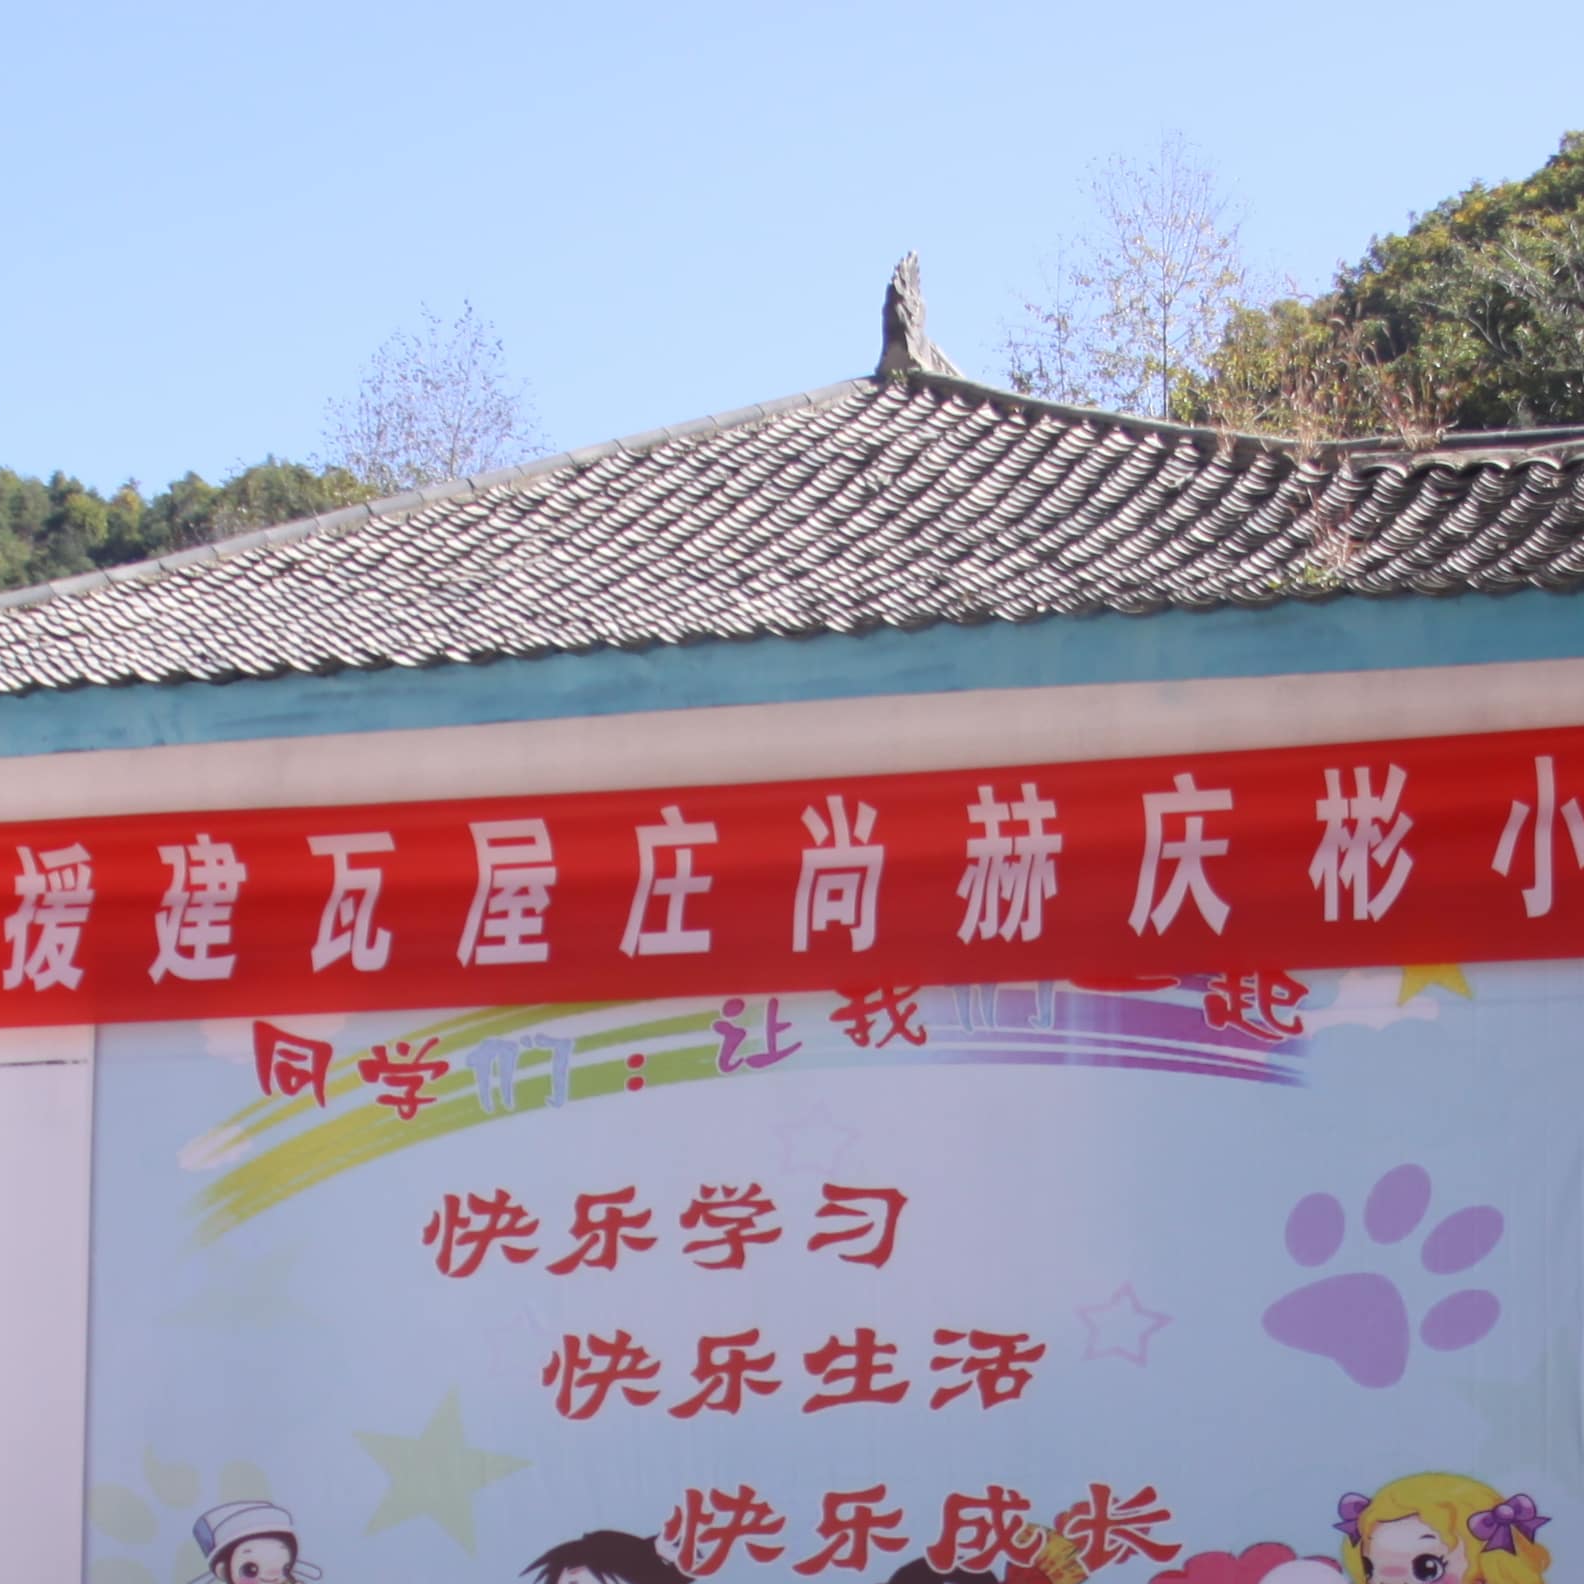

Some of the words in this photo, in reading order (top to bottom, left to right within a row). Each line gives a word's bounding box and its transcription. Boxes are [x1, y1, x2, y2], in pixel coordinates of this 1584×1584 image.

[422, 1183, 909, 1279] 快乐学习
[540, 1328, 1047, 1420] 快乐生活
[663, 1482, 1184, 1578] 快乐成长
